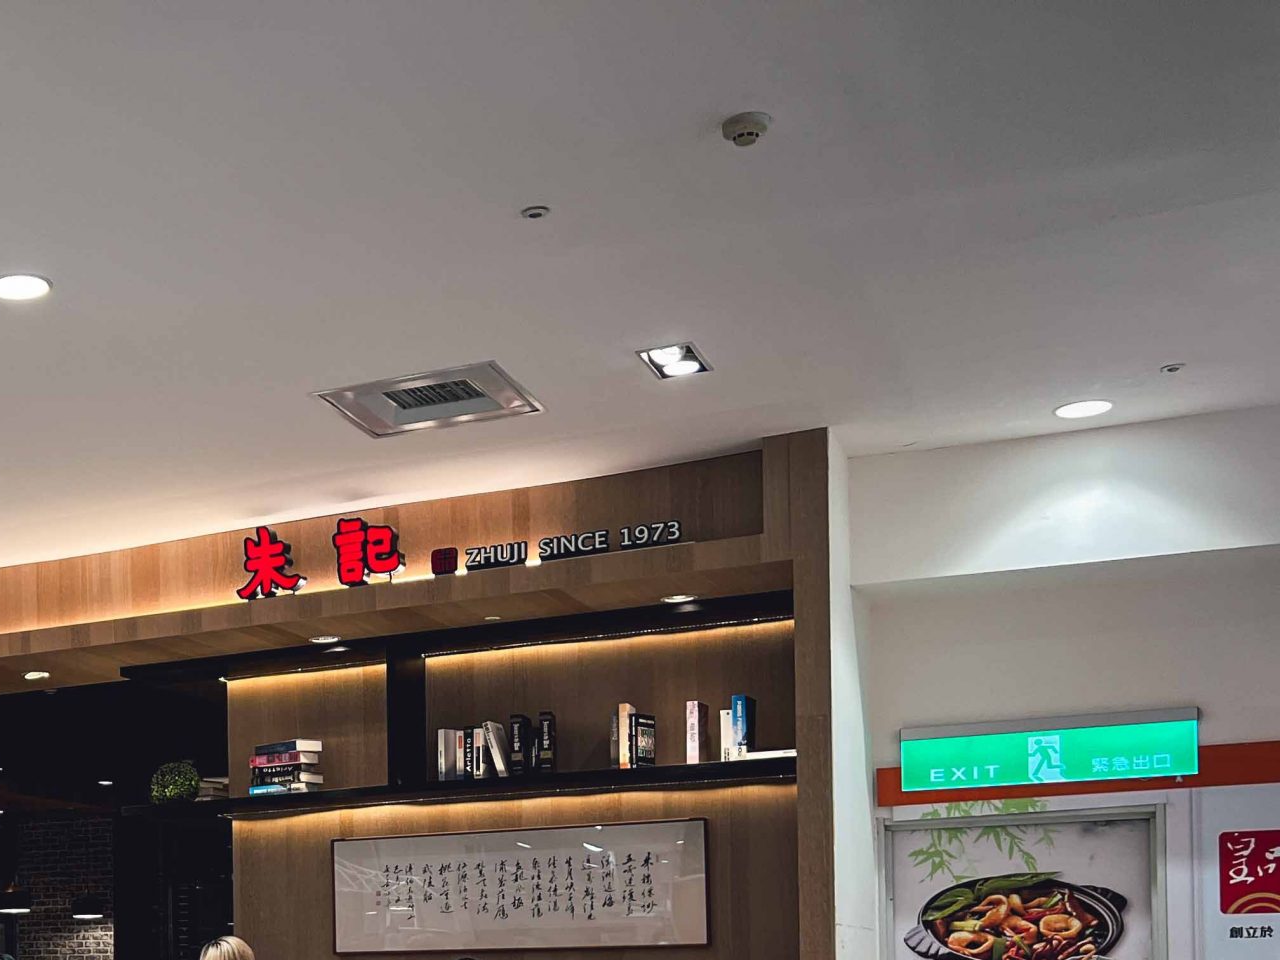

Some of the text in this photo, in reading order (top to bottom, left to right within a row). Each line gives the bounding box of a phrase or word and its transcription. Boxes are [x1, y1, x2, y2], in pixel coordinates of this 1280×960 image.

[466, 522, 681, 566] ZHUJI SINCE 1973
[236, 518, 400, 599] 朱記
[1091, 754, 1171, 772] 緊急出口
[930, 765, 1000, 782] EXIT
[1229, 925, 1274, 939] 創立於
